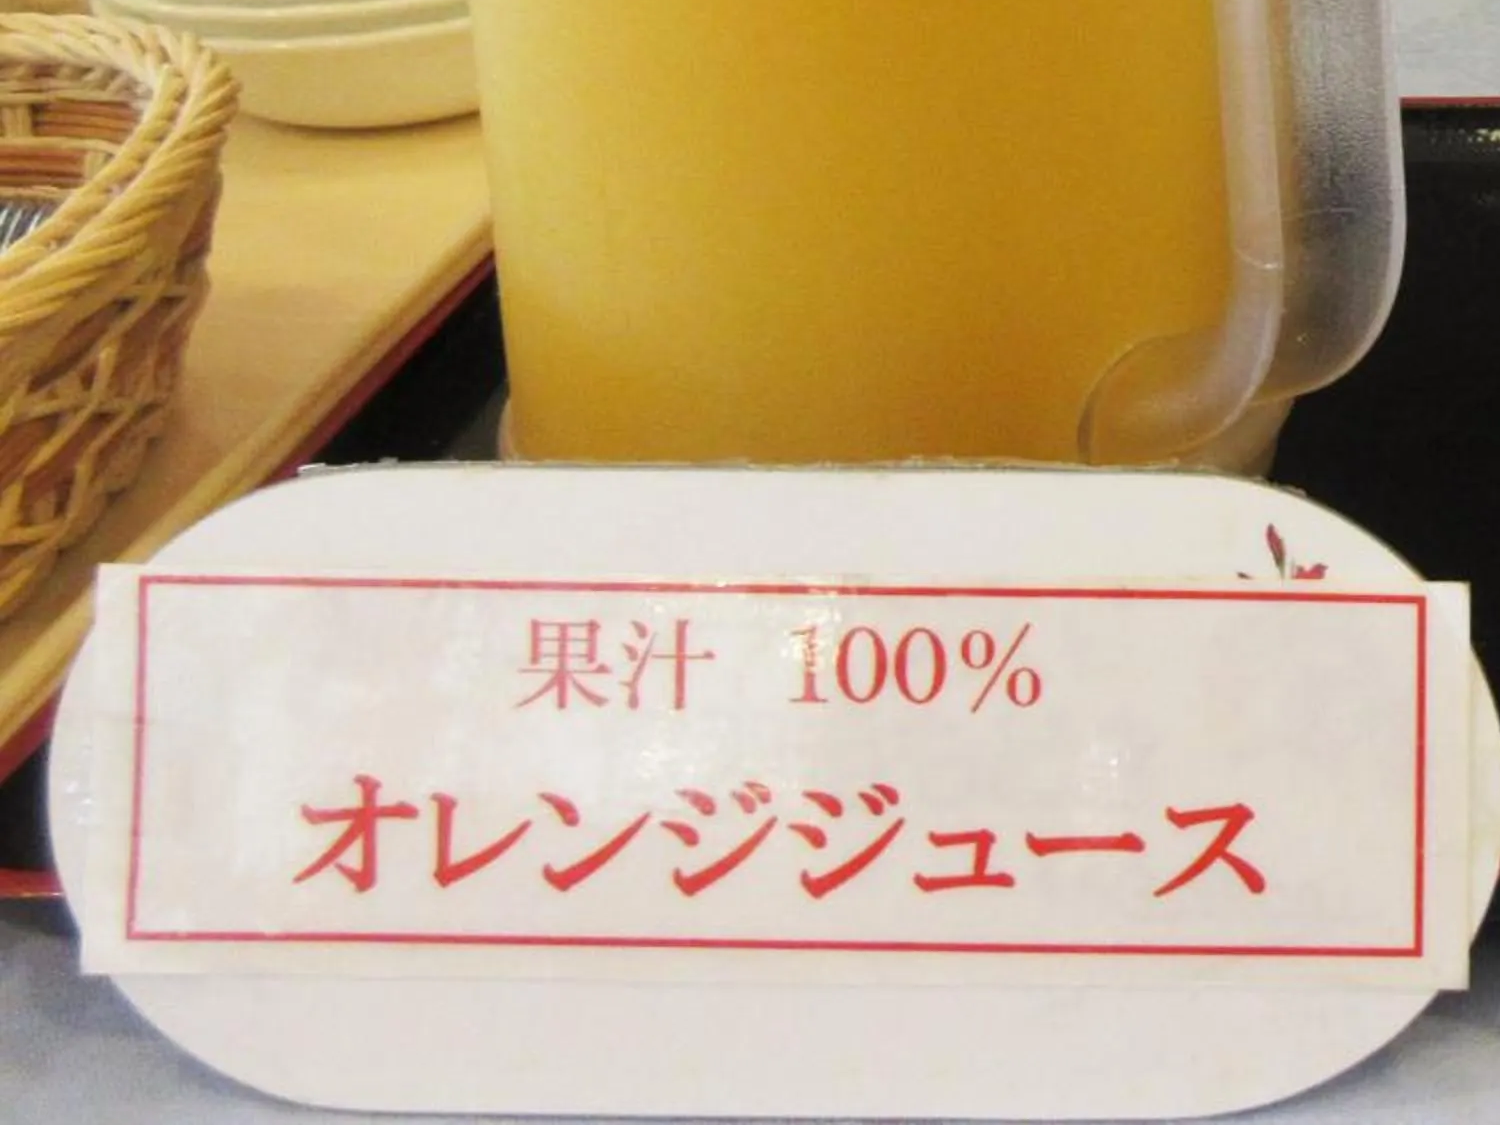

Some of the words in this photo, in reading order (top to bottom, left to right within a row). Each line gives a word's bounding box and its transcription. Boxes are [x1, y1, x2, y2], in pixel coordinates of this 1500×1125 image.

[516, 619, 715, 712] 果汁
[788, 623, 1043, 711] 100%
[293, 774, 1269, 900] オレンジジュース
